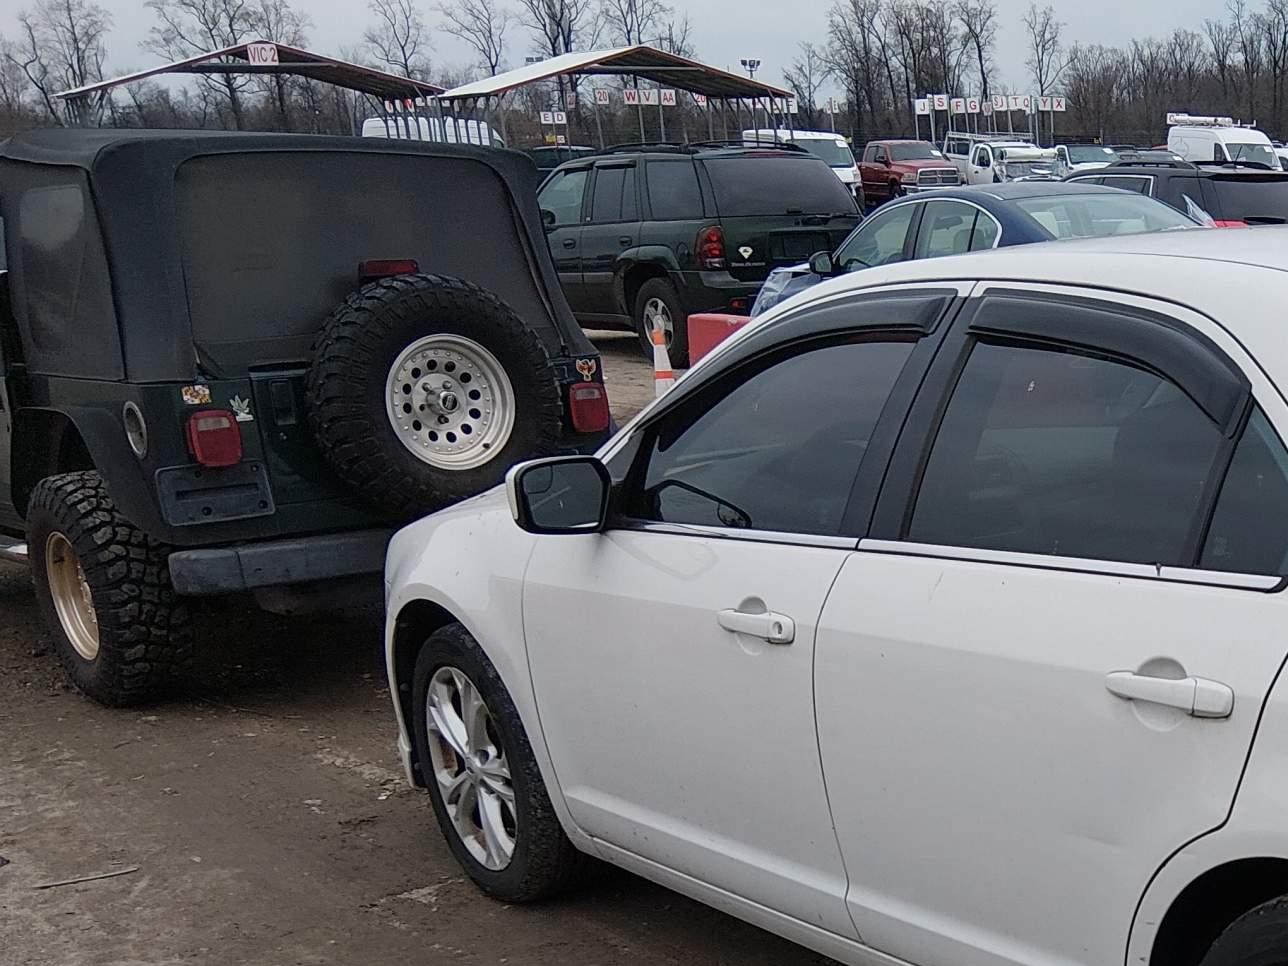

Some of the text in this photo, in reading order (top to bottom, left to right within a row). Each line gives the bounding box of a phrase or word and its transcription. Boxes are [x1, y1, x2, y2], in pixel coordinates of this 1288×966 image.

[249, 47, 277, 62] VIC 2
[597, 91, 607, 101] 20
[625, 90, 637, 100] W
[643, 90, 651, 100] V
[663, 92, 673, 101] AA
